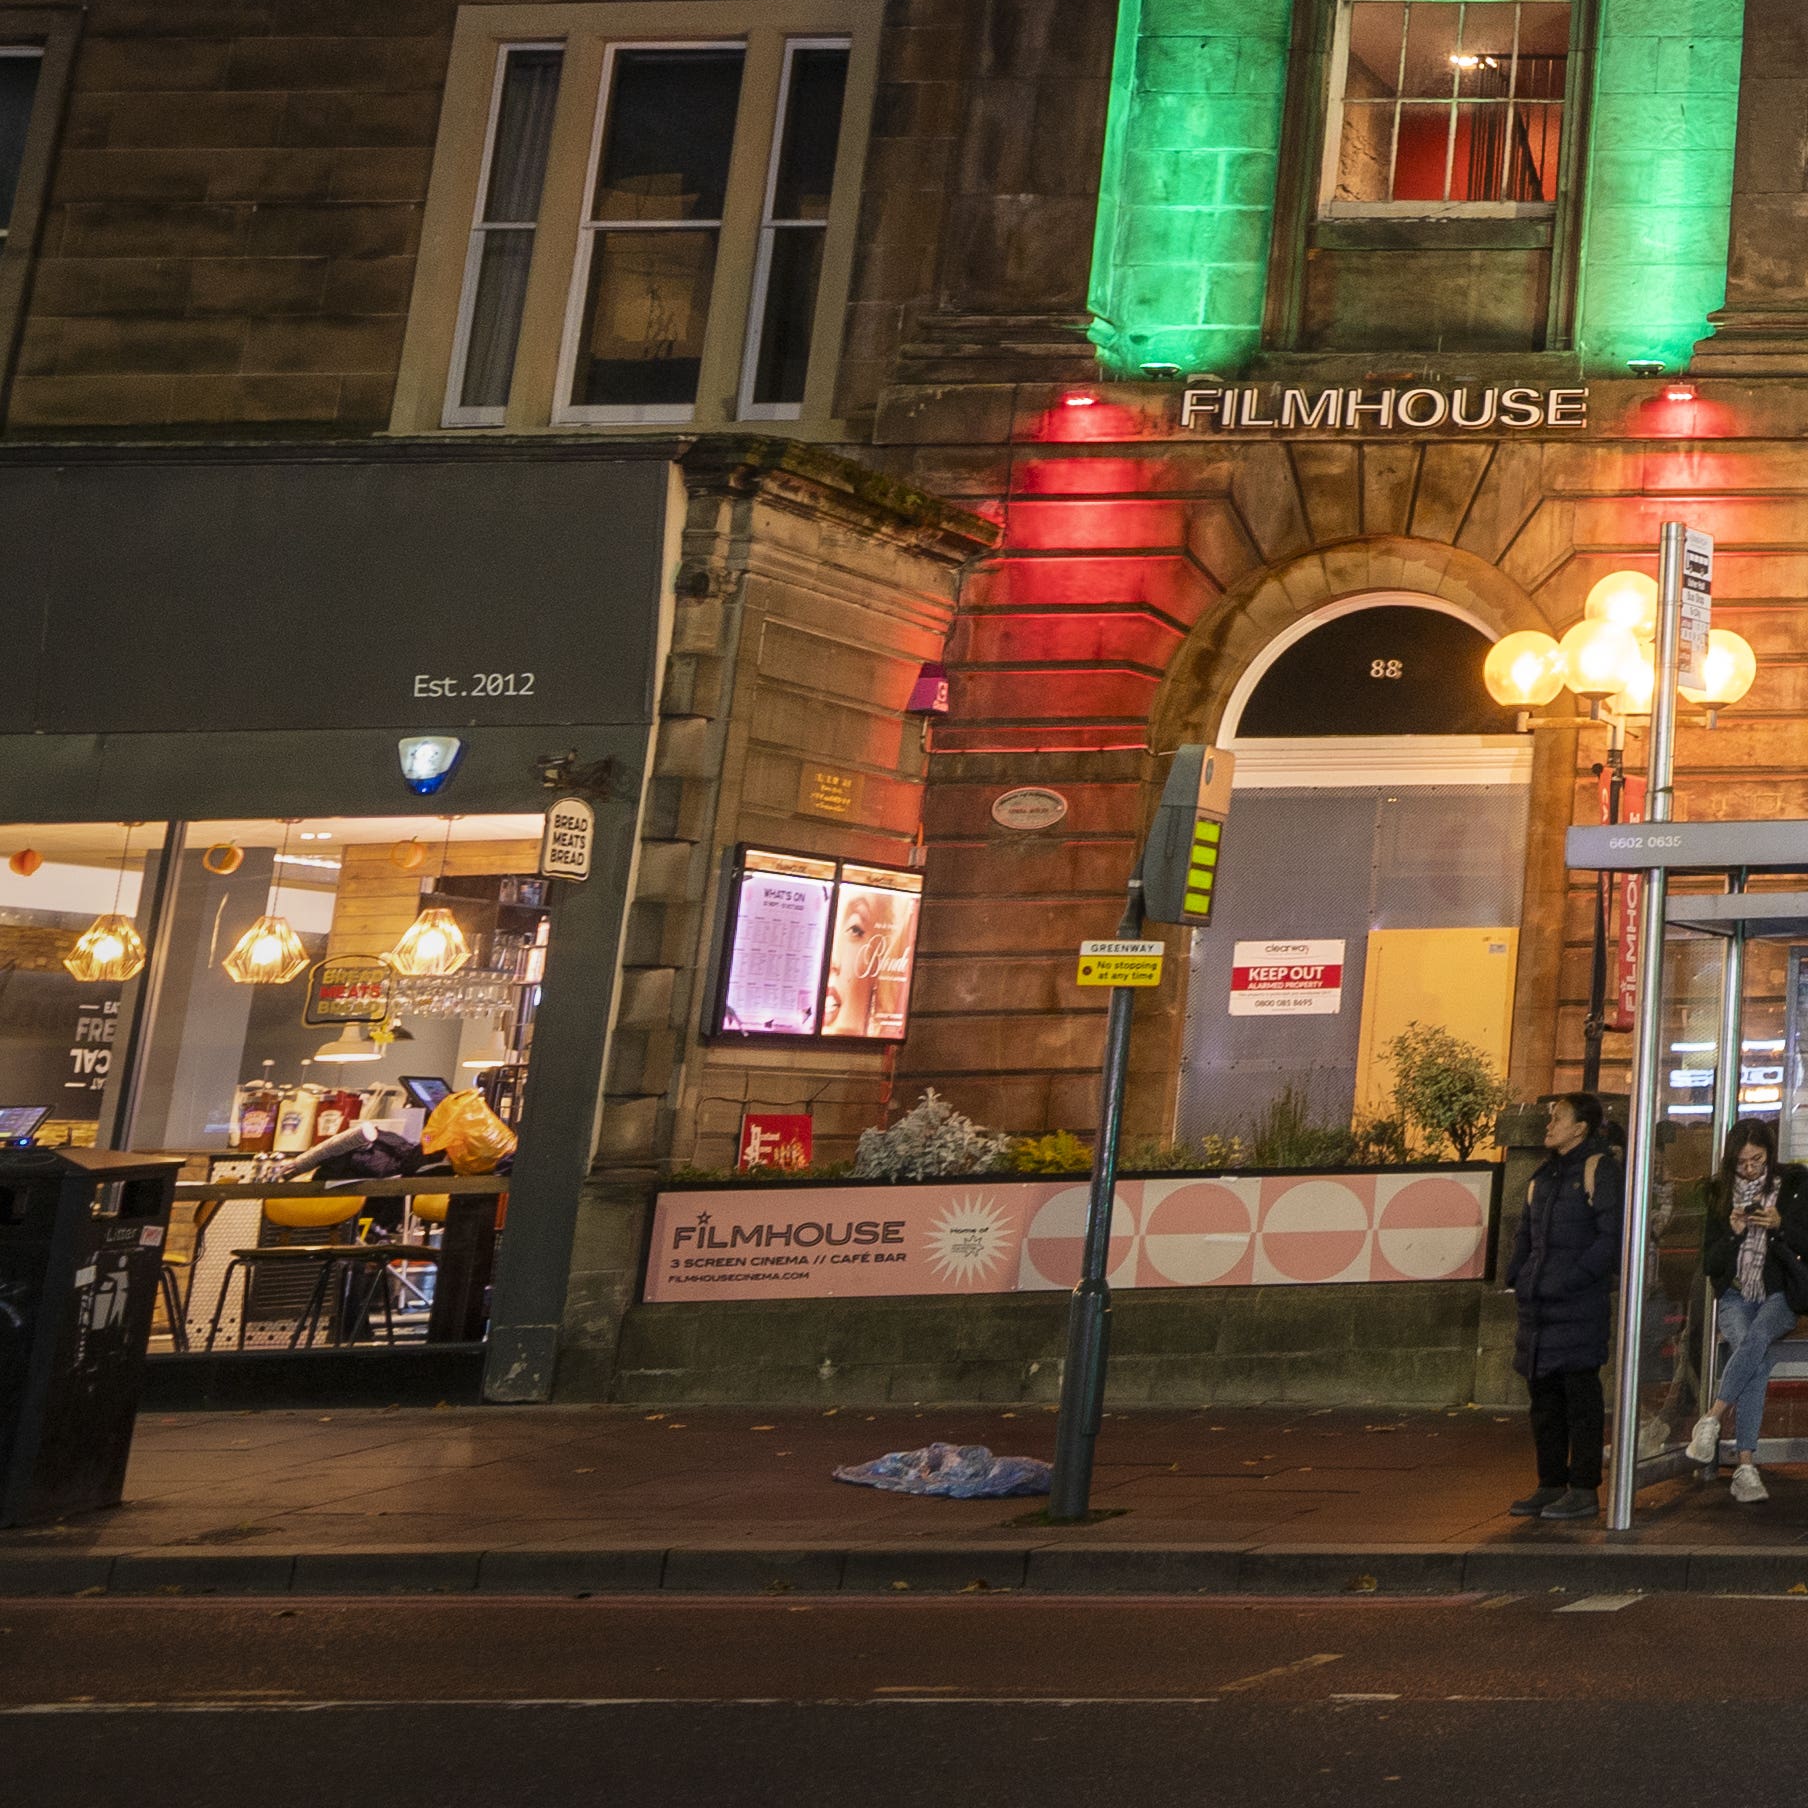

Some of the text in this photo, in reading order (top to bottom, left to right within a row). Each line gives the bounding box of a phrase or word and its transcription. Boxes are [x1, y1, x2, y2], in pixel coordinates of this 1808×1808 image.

[1179, 386, 1590, 430] FILMHOUSE
[1370, 659, 1404, 679] 88
[413, 672, 536, 697] Est.2012
[554, 813, 588, 832] BREAD
[552, 831, 587, 849] MEATS
[1609, 837, 1644, 850] 6602
[550, 851, 585, 867] BREAD
[792, 890, 806, 903] ON
[1090, 944, 1155, 953] GREENWAY
[1265, 944, 1310, 955] clearway
[1096, 960, 1158, 973] No stopping
[1248, 966, 1325, 982] KEEP OUT
[1097, 971, 1155, 982] at any time
[320, 983, 382, 999] MEATS
[1247, 981, 1323, 990] ALARMED PROPERTY
[673, 1210, 907, 1249] FILMHOUSE
[670, 1258, 680, 1269] 3
[684, 1257, 747, 1269] SCREEN
[750, 1255, 810, 1267] CINEMA
[830, 1250, 870, 1265] CAFÉ
[874, 1252, 907, 1264] BAR
[667, 1272, 810, 1284] FILMHOUSECINEMA.COM
